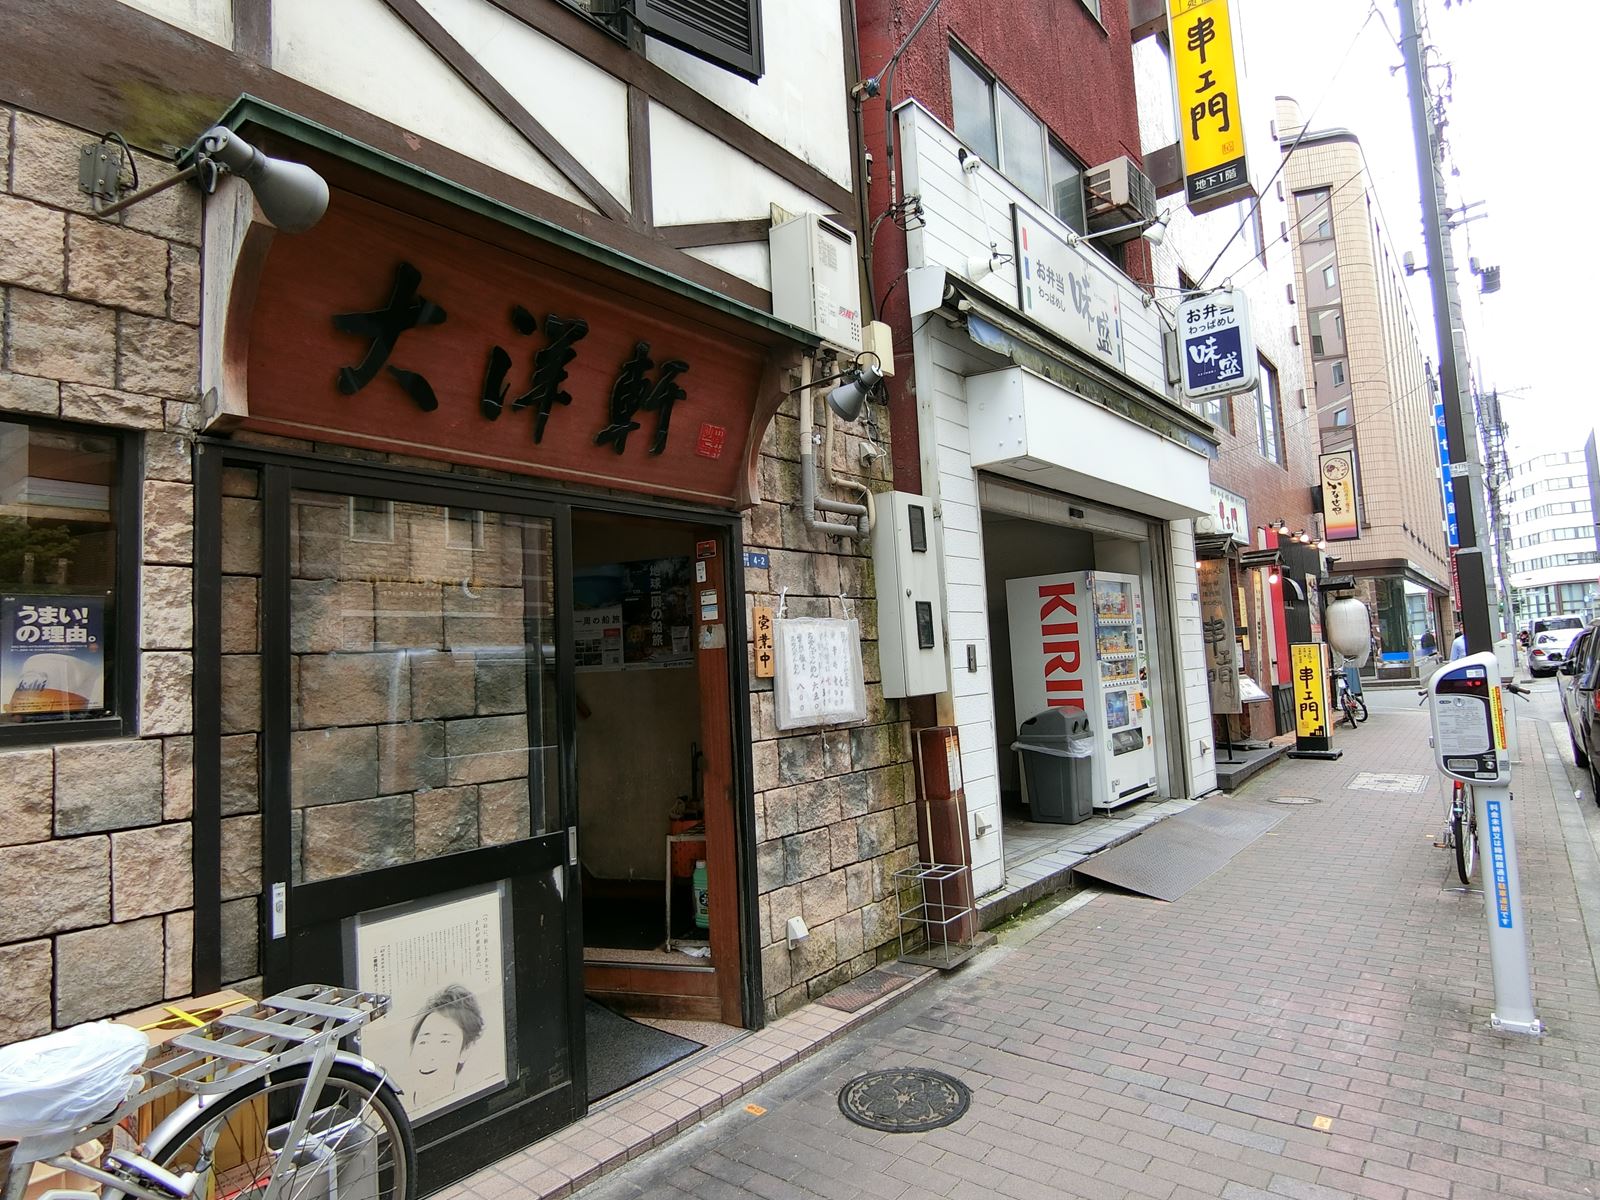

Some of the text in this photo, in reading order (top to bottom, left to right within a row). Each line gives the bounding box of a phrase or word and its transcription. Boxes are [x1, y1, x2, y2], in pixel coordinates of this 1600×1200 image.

[1036, 259, 1065, 296] お弁当
[1038, 286, 1066, 313] わっぱめし
[1068, 271, 1112, 356] 味盛
[1188, 315, 1236, 335] わっぱめし
[333, 262, 690, 456] 大洋軒
[1189, 336, 1242, 380] 味盛
[753, 555, 765, 566] 4-2
[18, 605, 89, 624] うまい!
[15, 625, 97, 643] の理由。
[757, 614, 773, 670] 営業中
[1038, 582, 1084, 707] KIRI
